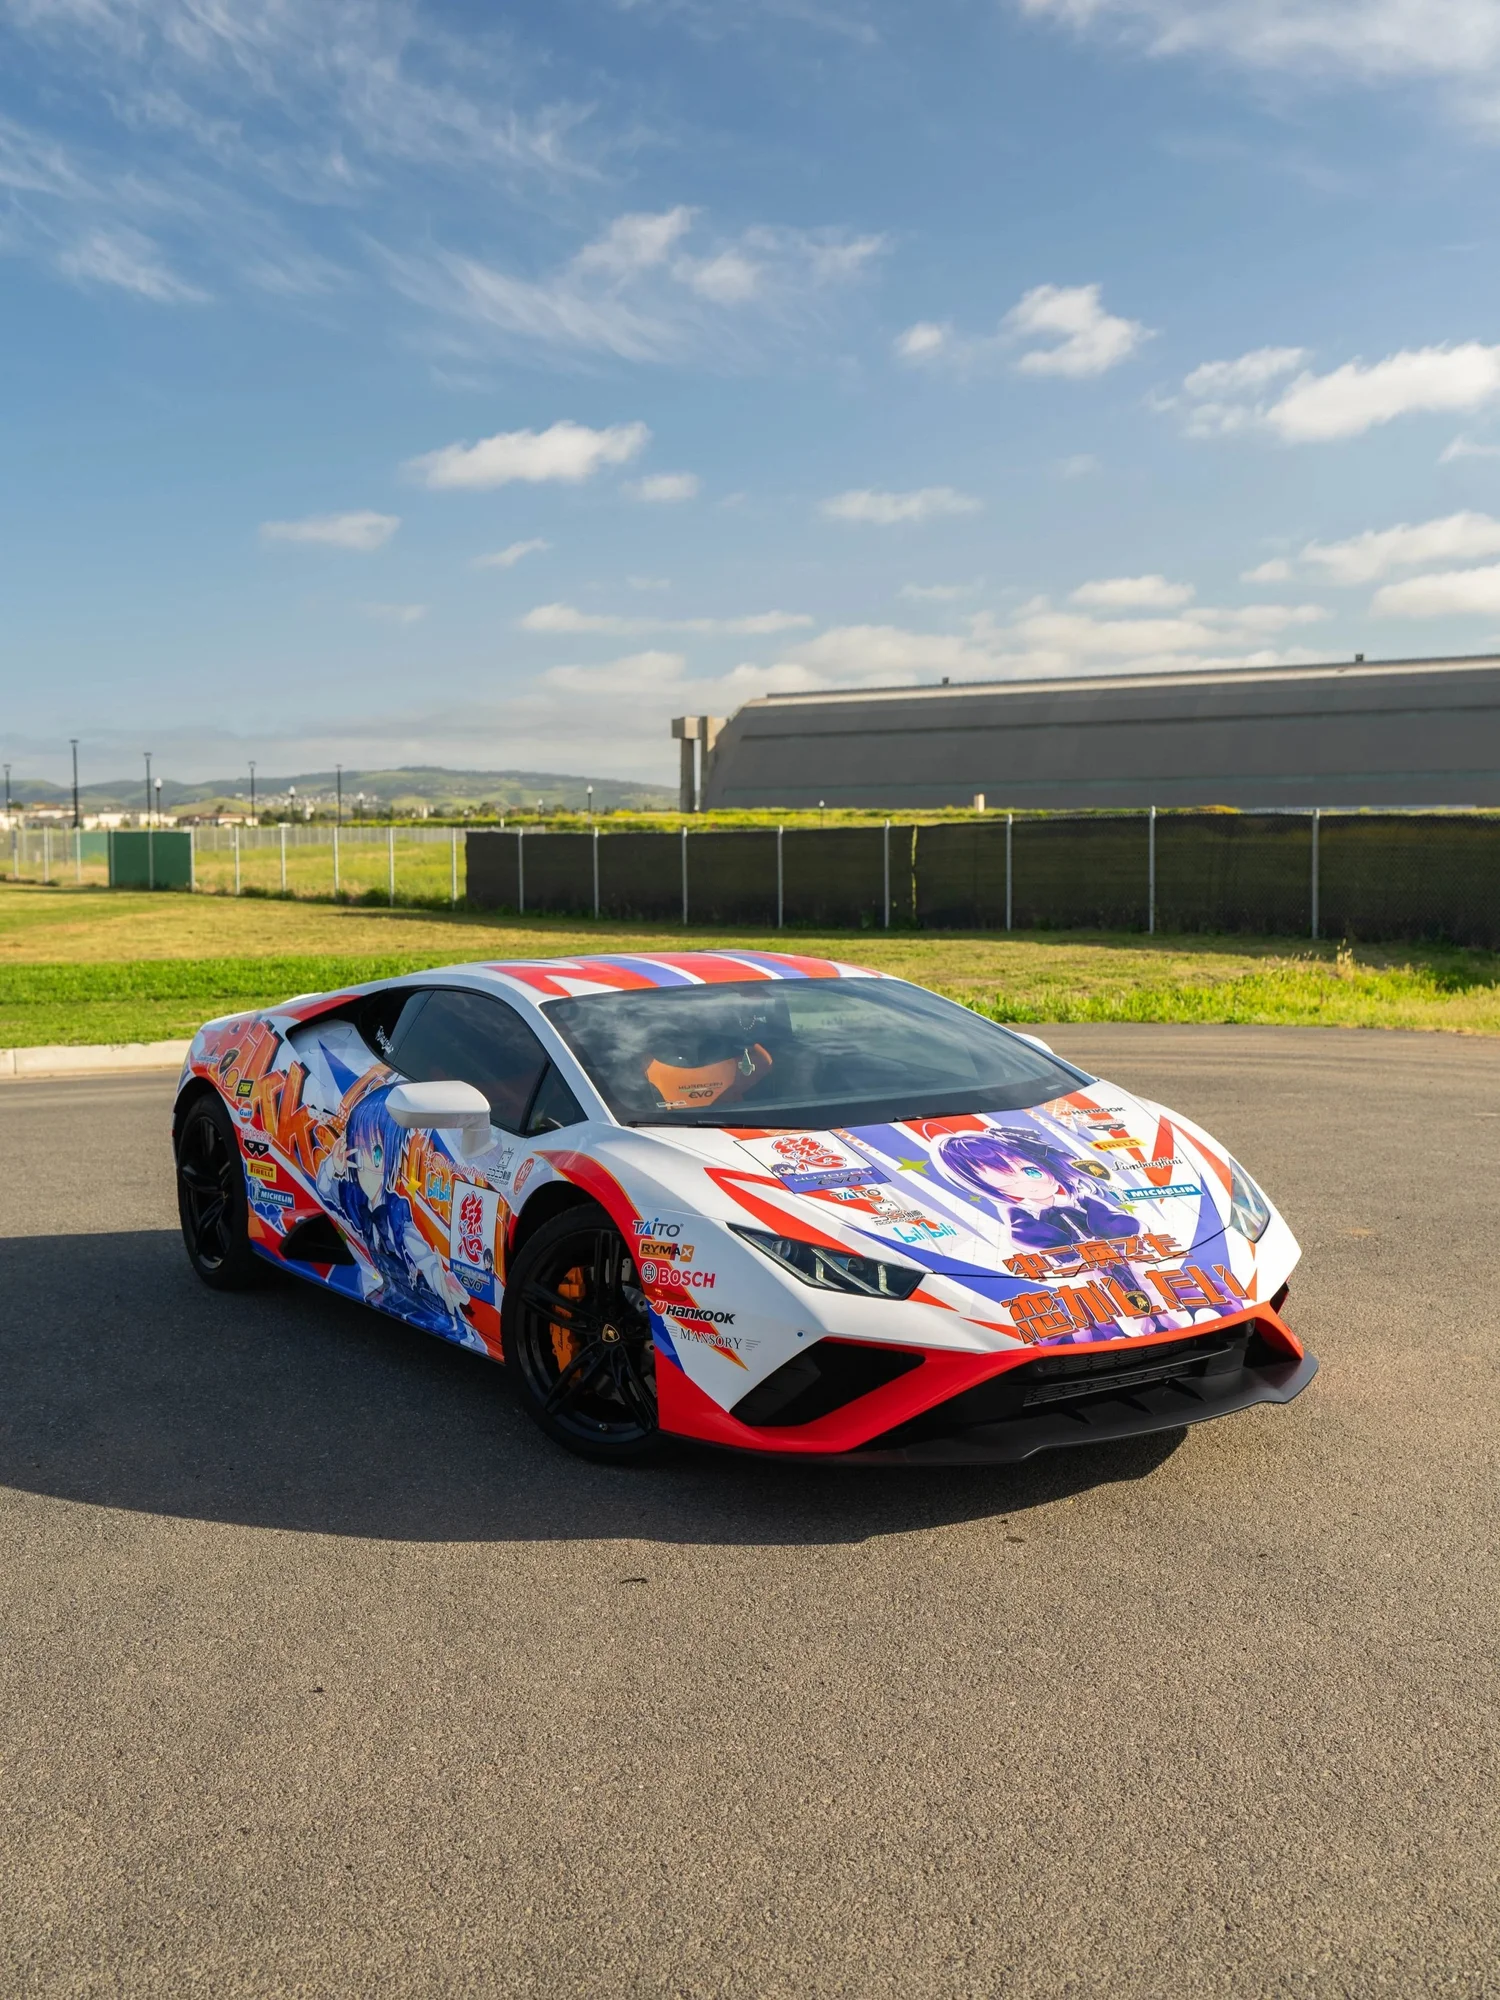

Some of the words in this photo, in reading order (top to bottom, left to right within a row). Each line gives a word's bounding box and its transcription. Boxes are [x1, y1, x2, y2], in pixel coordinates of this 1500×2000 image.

[689, 1090, 713, 1098] EVO
[251, 1163, 273, 1178] PIRELLI
[1112, 1156, 1183, 1171] Lamborghini
[261, 1191, 292, 1204] MICHELIN
[1131, 1186, 1196, 1198] MICHELIN
[893, 1222, 957, 1243] bilibili
[640, 1243, 692, 1258] RYMAX
[461, 1275, 483, 1292] EVO
[659, 1269, 716, 1288] BOSCH
[680, 1328, 742, 1349] MANSORY
